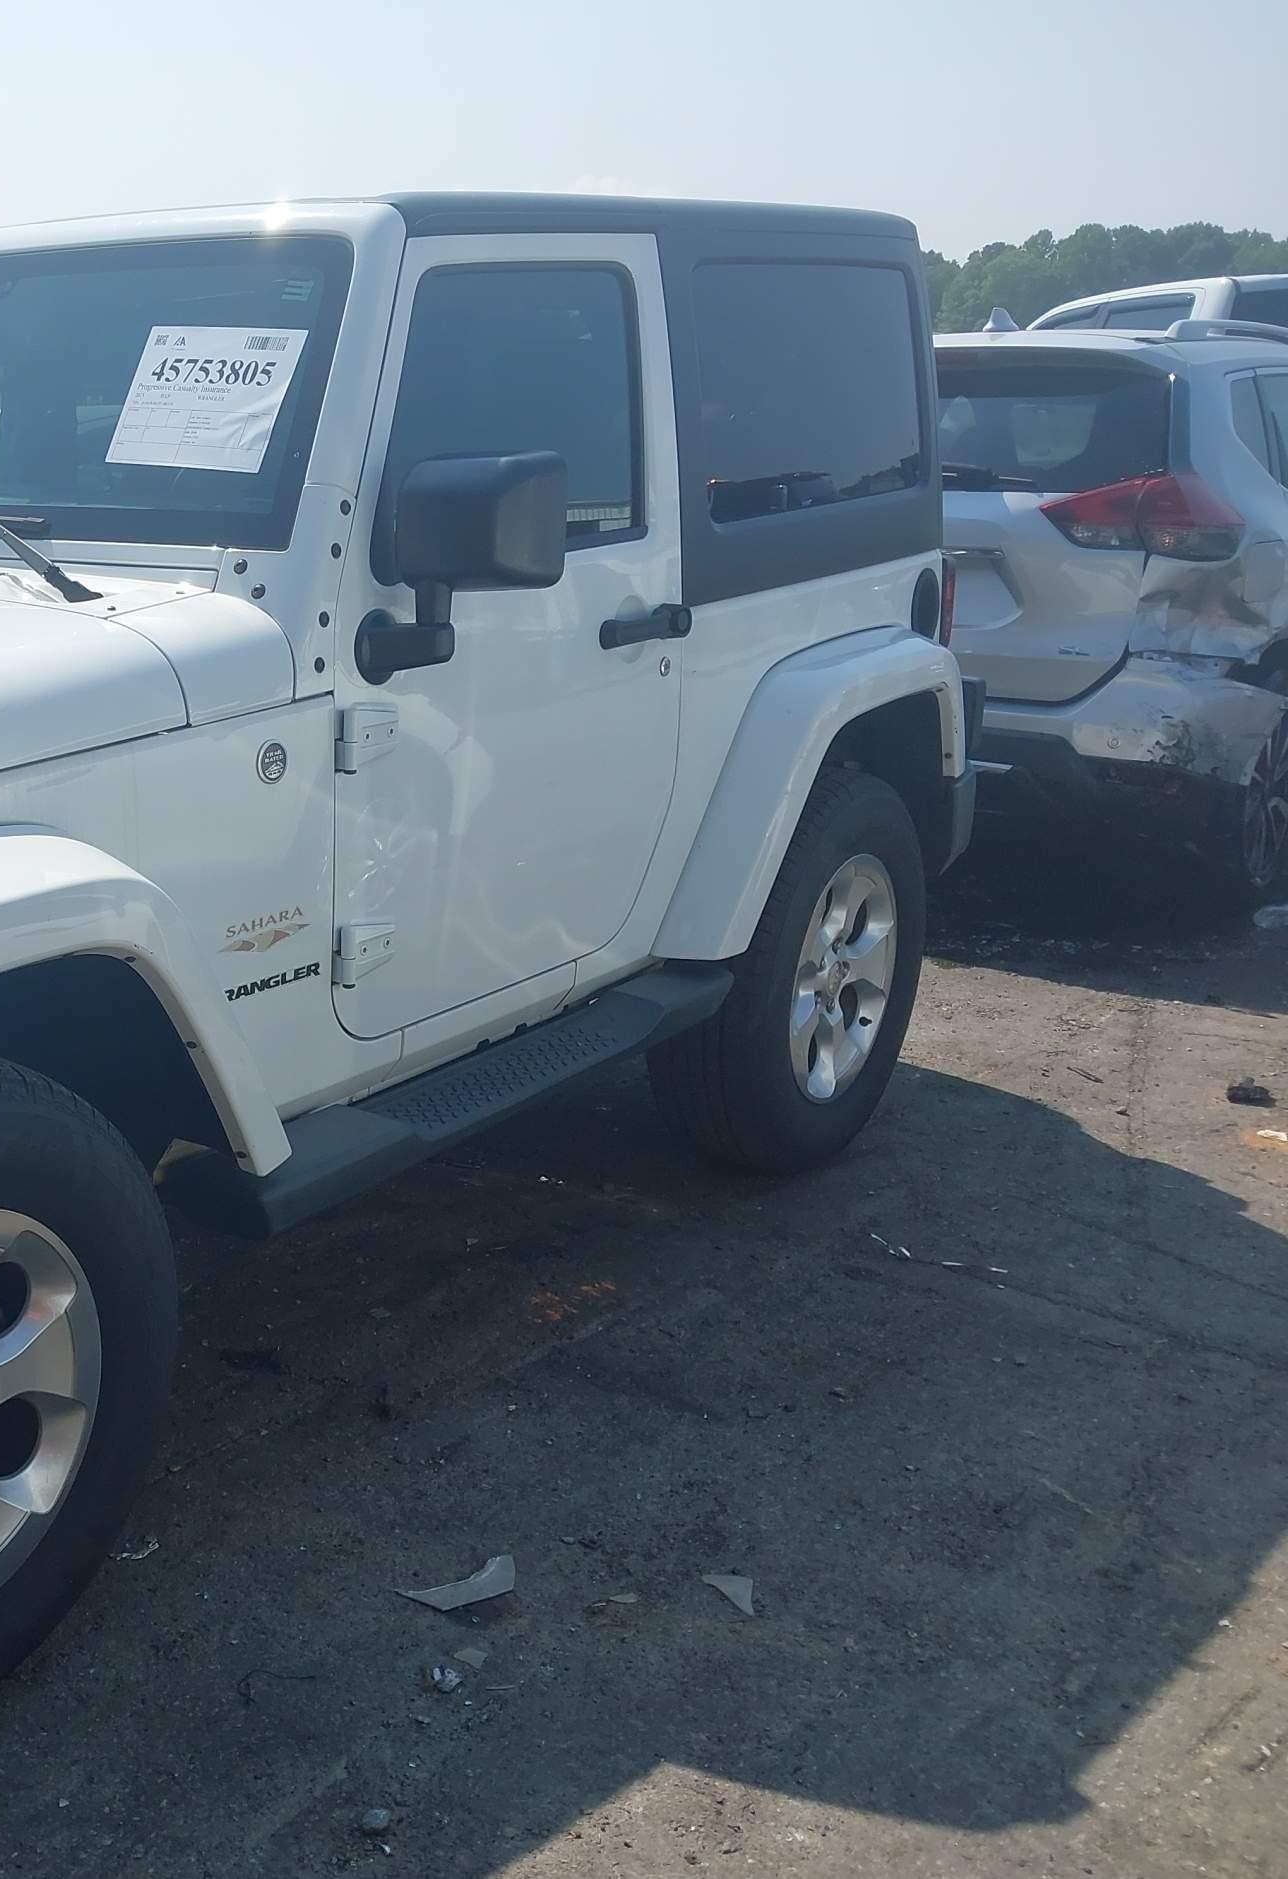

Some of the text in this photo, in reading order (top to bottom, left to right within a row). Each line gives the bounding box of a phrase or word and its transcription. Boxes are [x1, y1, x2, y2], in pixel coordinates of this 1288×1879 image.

[151, 357, 277, 386] 45753805
[137, 383, 232, 394] Progressive Casualty Insurance
[226, 906, 303, 938] SAHARA
